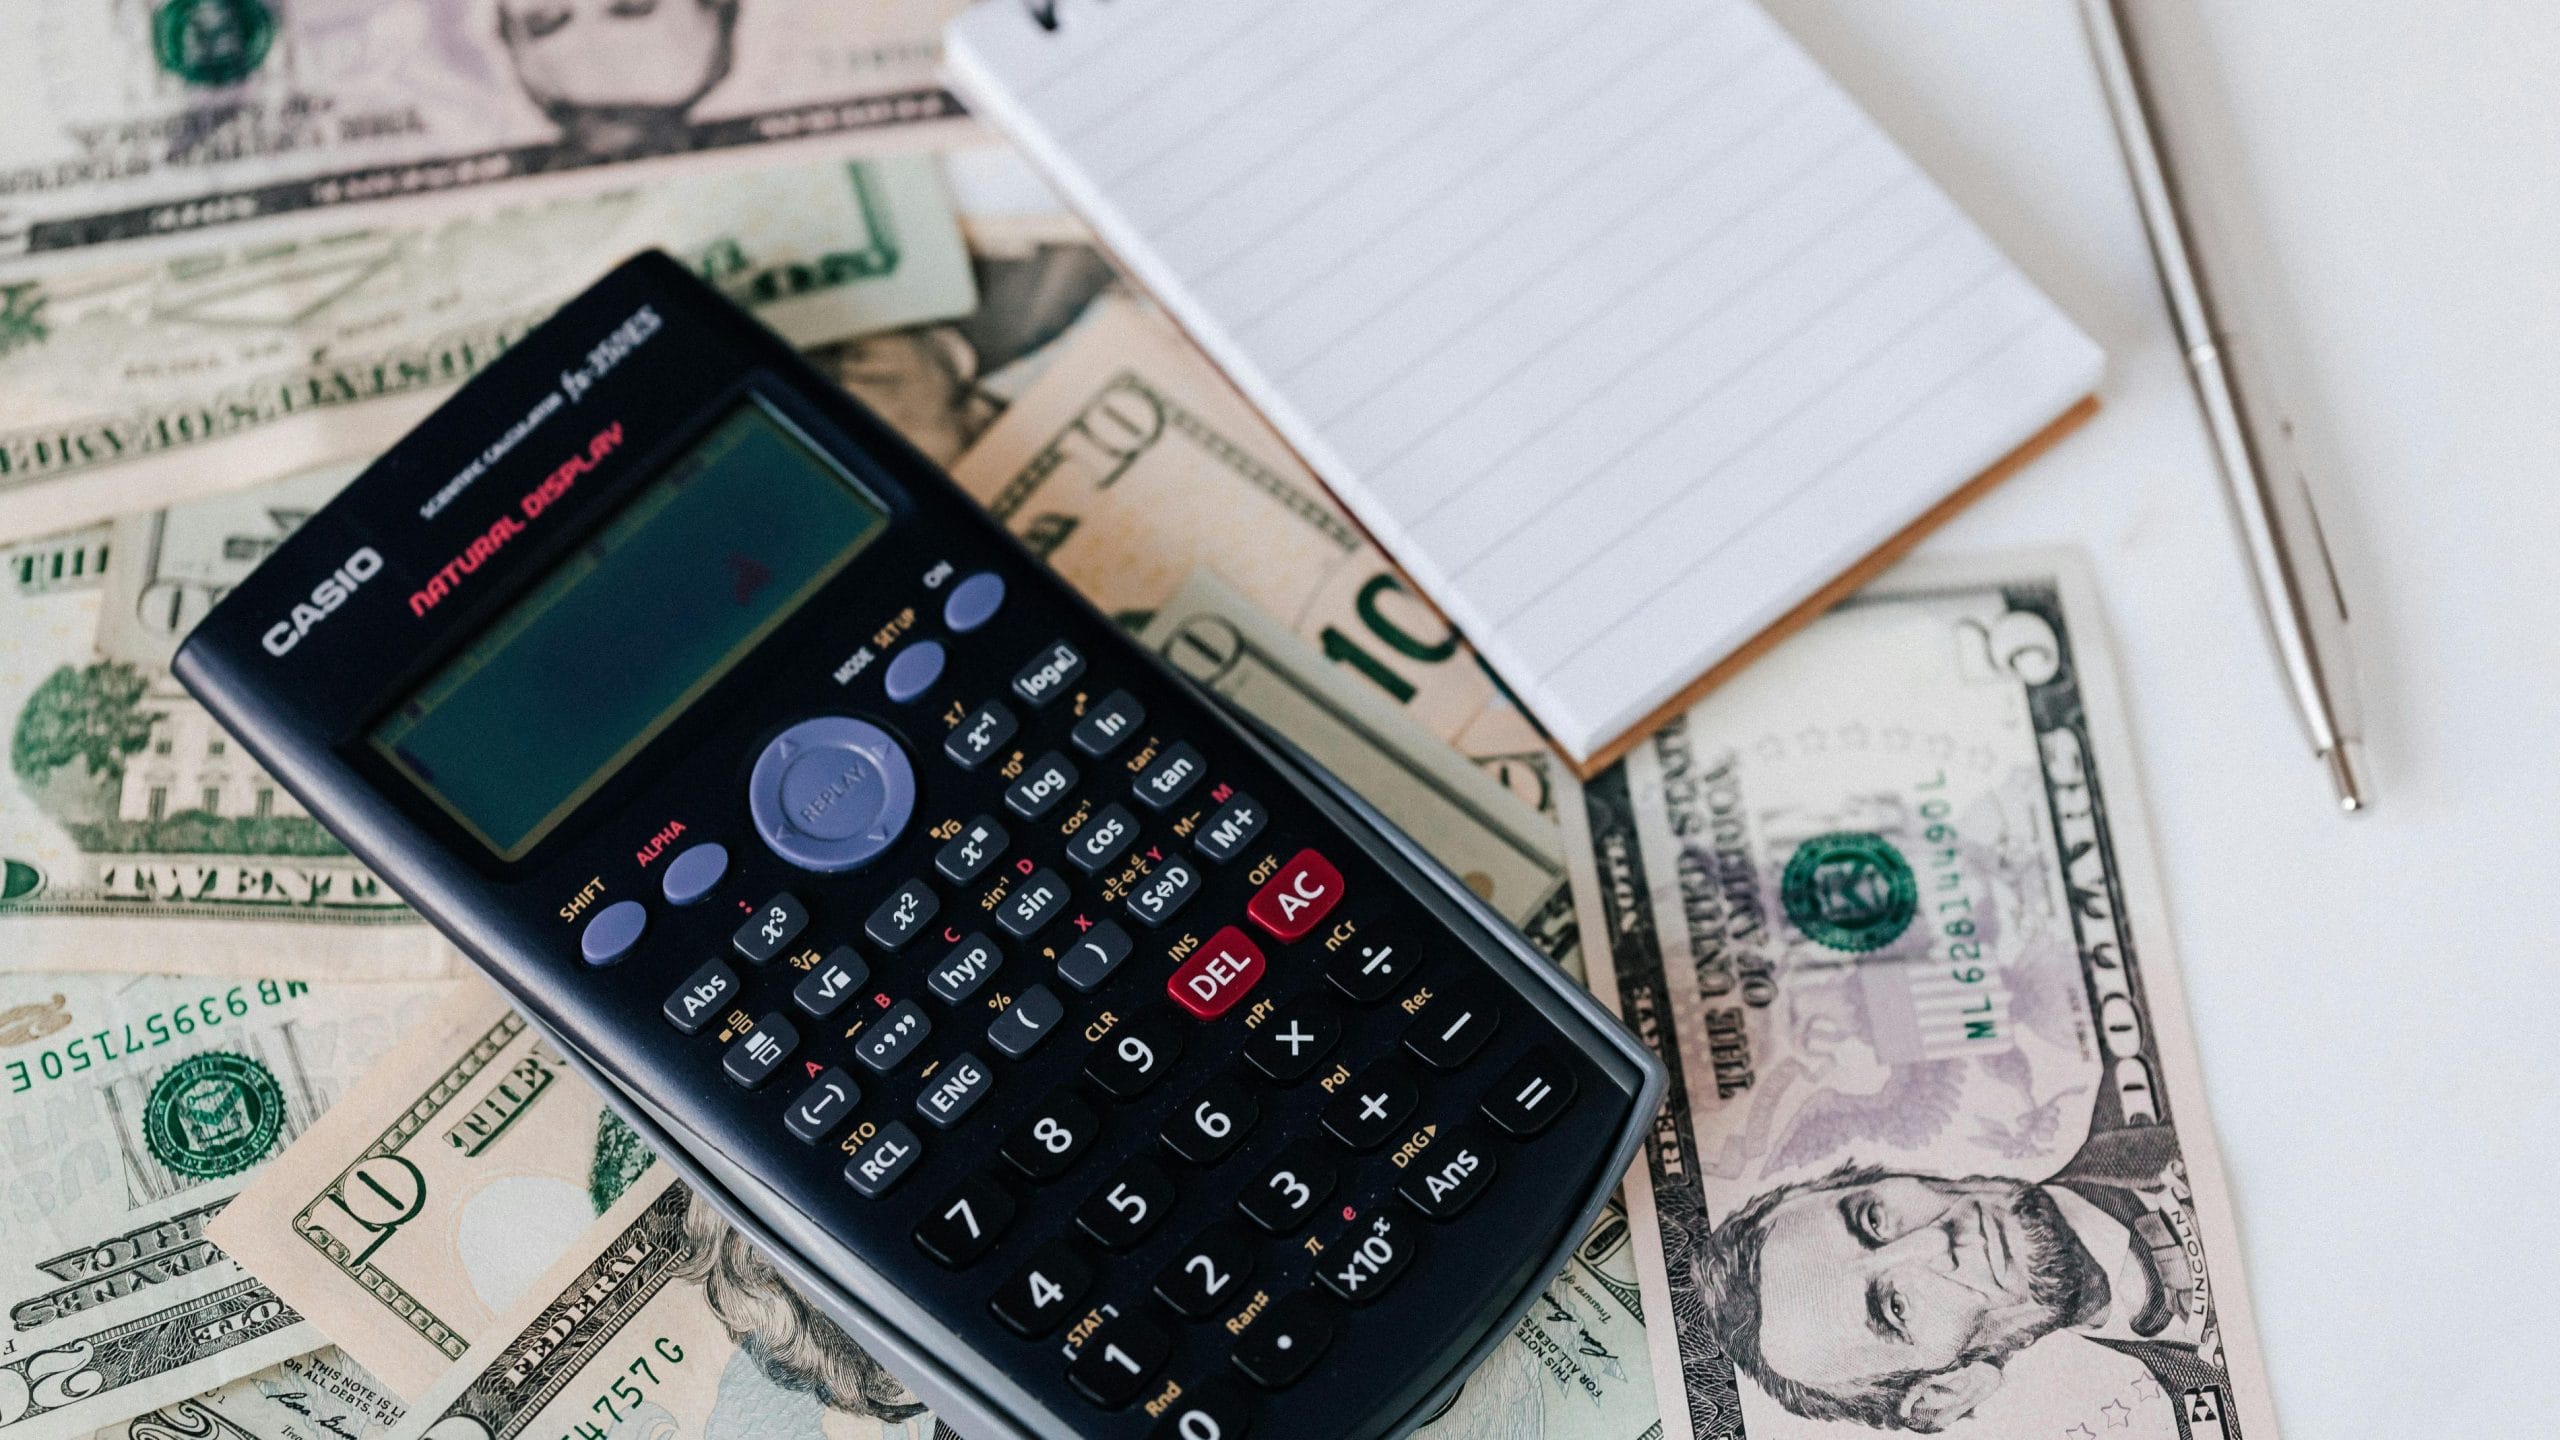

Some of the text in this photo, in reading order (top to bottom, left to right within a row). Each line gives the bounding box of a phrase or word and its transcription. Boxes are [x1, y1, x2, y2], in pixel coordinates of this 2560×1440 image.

[408, 514, 526, 618] NATURAL
[520, 420, 623, 520] DISPLAY
[922, 560, 953, 588] ON
[261, 545, 385, 657] CASIO
[1320, 573, 1462, 703] 10
[833, 646, 875, 685] MODE
[1095, 710, 1126, 736] ln
[800, 762, 868, 823] REPLAY
[1021, 767, 1066, 803] log
[1152, 756, 1193, 793] tan
[1211, 783, 1234, 803] M
[635, 820, 686, 868] ALPHA
[1086, 818, 1124, 854] cos
[1211, 808, 1253, 849] M+
[1016, 858, 1034, 874] D
[1147, 846, 1163, 861] Y
[1249, 854, 1280, 885] OFF
[103, 862, 394, 908] TWENT
[559, 875, 607, 923] SHIFT
[1017, 887, 1053, 920] sin
[1277, 871, 1325, 922] AC
[944, 927, 961, 943] C
[1073, 914, 1093, 933] X
[1325, 920, 1356, 951] nCr
[2039, 726, 2163, 1127] DOLLARS
[1167, 933, 1199, 962] INS
[940, 947, 988, 988] hyp
[1188, 950, 1251, 1001] DEL
[682, 975, 727, 1017] Abs
[874, 993, 891, 1009] B
[1245, 998, 1275, 1029] nPr
[1401, 987, 1433, 1015] Rec
[1085, 1011, 1119, 1042] CLR
[805, 1061, 823, 1078] A
[1118, 1037, 1154, 1074] 9
[1705, 1006, 1755, 1100] THE
[930, 1064, 982, 1113] ENG
[1321, 1064, 1351, 1094] Pol
[443, 1057, 555, 1157] THE
[1195, 1100, 1231, 1138] 6
[840, 1121, 877, 1156] STO
[1033, 1117, 1073, 1154] 8
[859, 1136, 910, 1183] RCL
[1425, 1149, 1479, 1203] Ans
[1106, 1183, 1148, 1224] 5
[1269, 1171, 1310, 1210] 3
[302, 1154, 428, 1268] 10
[944, 1198, 982, 1239] 7
[1342, 1206, 1357, 1221] e
[1184, 1255, 1230, 1295] 2
[2172, 1209, 2207, 1316] LINCOLN
[1028, 1270, 1065, 1309] 4
[194, 1294, 285, 1344] OTE
[505, 1238, 657, 1388] FEDERAL
[1066, 1308, 1105, 1348] STAT
[1226, 1290, 1269, 1336] Ran#
[1104, 1342, 1142, 1374] 1
[1514, 1327, 1571, 1385] THIS NOTE
[1559, 1352, 1582, 1374] ALL
[303, 1370, 328, 1388] ALL
[310, 1359, 342, 1381] THIS
[343, 1377, 377, 1401] NOTE
[376, 1397, 390, 1411] IS
[561, 1355, 661, 1440] 4757
[1580, 1374, 1604, 1398] FOR
[1144, 1380, 1184, 1418] Rnd
[1178, 1408, 1221, 1440] 0
